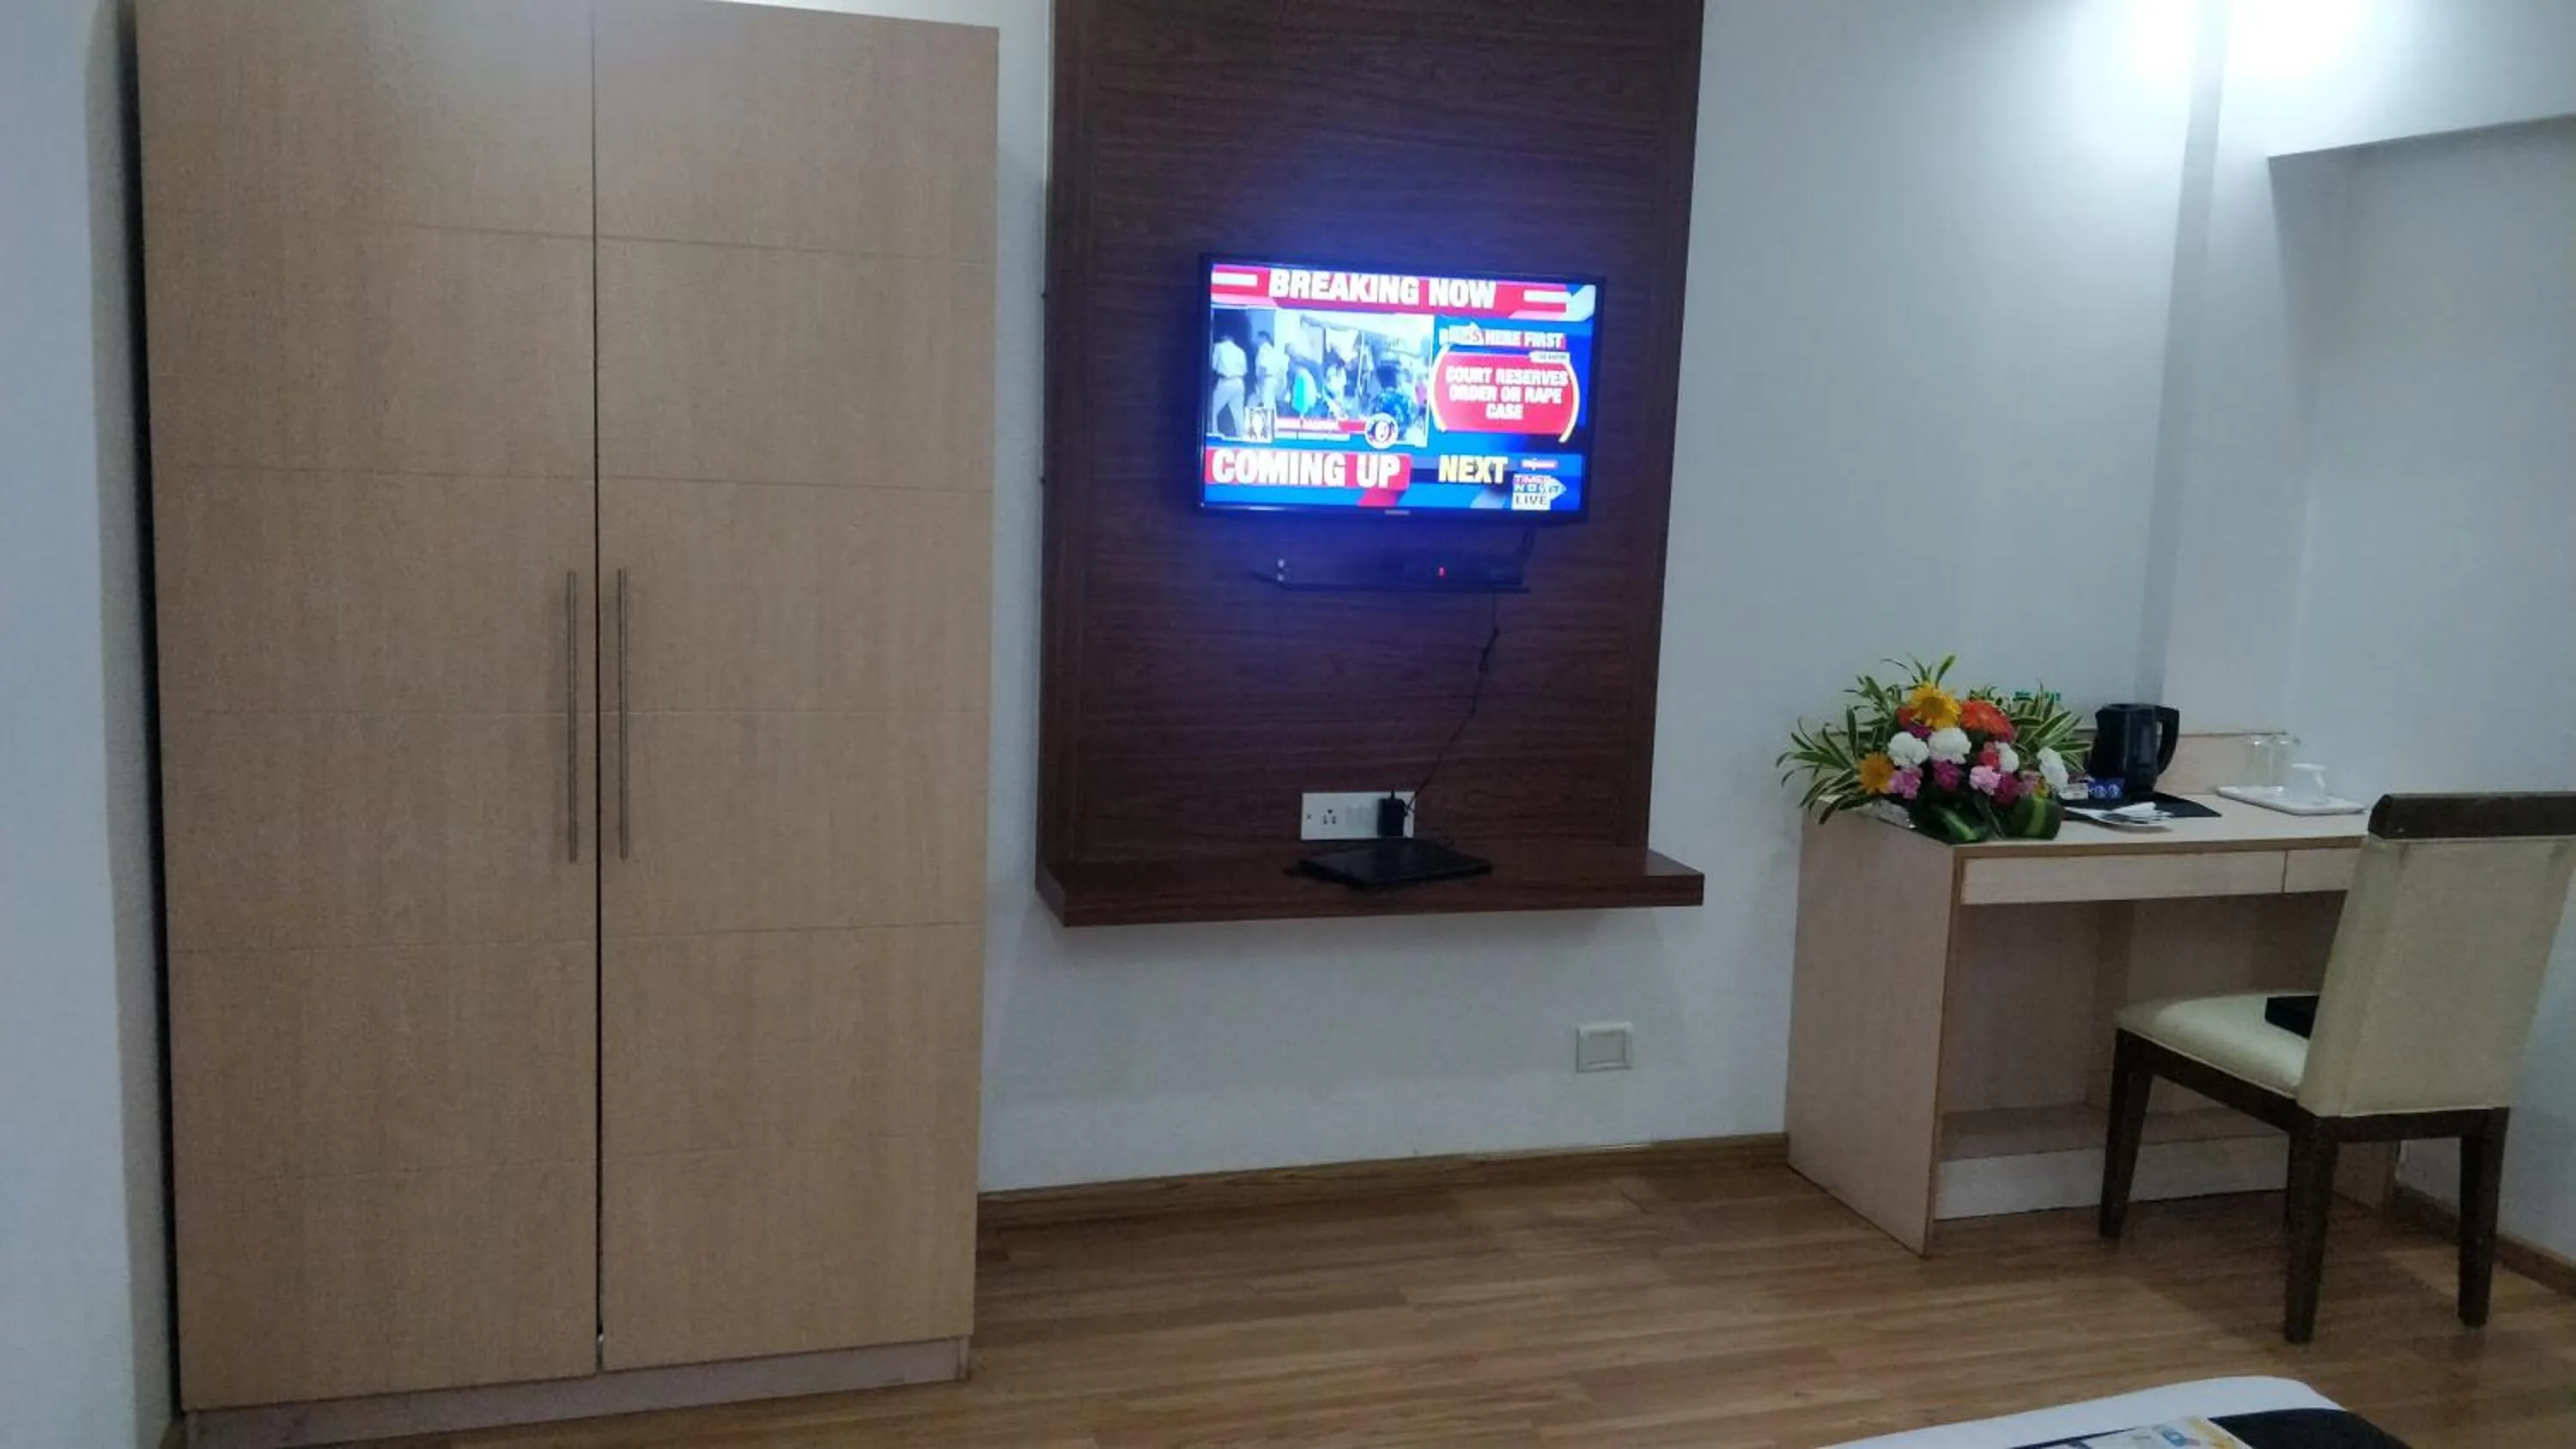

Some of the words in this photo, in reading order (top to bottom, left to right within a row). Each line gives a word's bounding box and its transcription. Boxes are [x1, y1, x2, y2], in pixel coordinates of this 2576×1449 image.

[1269, 269, 1419, 306] BREAKING
[1428, 278, 1497, 309] NOW
[1525, 331, 1563, 348] FIRST
[1446, 367, 1492, 384] COURT
[1496, 369, 1568, 385] RESERVES
[1449, 385, 1497, 402] ORDER
[1501, 387, 1521, 402] ON
[1525, 387, 1563, 403] RAPE
[1485, 404, 1523, 420] CASE
[1212, 452, 1346, 488] COMING
[1357, 453, 1401, 488] UP
[1439, 454, 1509, 484] NEXT
[1516, 495, 1547, 506] LIVE
